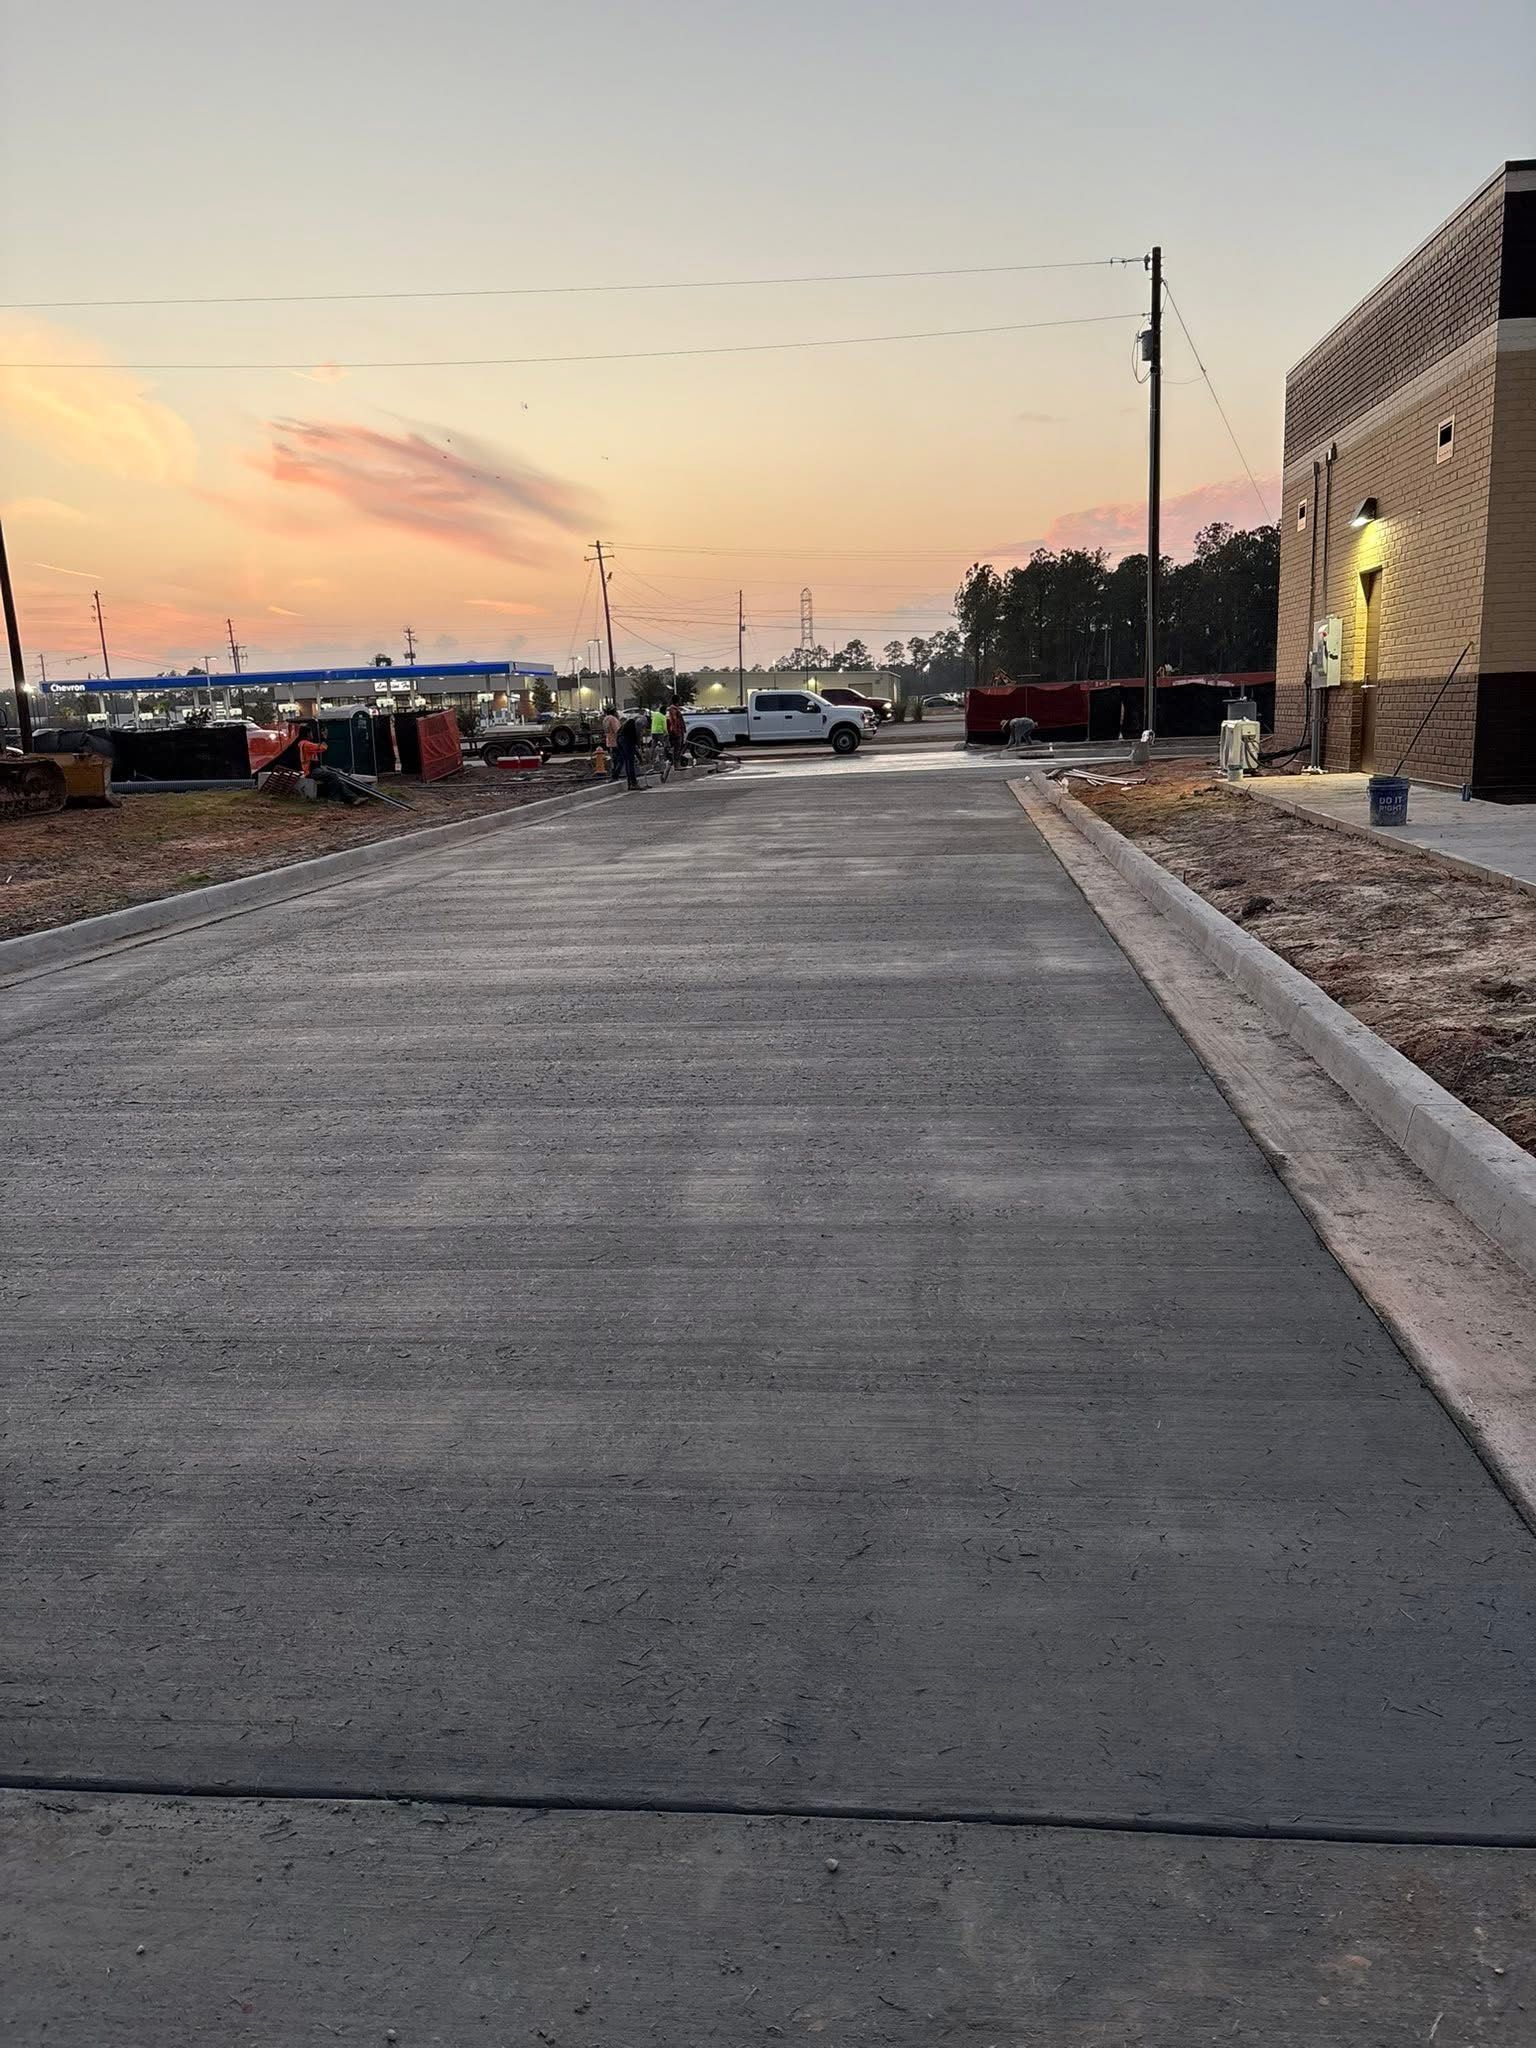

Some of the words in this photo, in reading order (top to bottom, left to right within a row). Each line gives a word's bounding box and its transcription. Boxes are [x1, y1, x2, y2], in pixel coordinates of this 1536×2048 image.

[50, 683, 86, 692] Chevron
[1379, 796, 1392, 804] DO
[1394, 796, 1402, 804] IT
[1379, 804, 1402, 812] RIGHT
